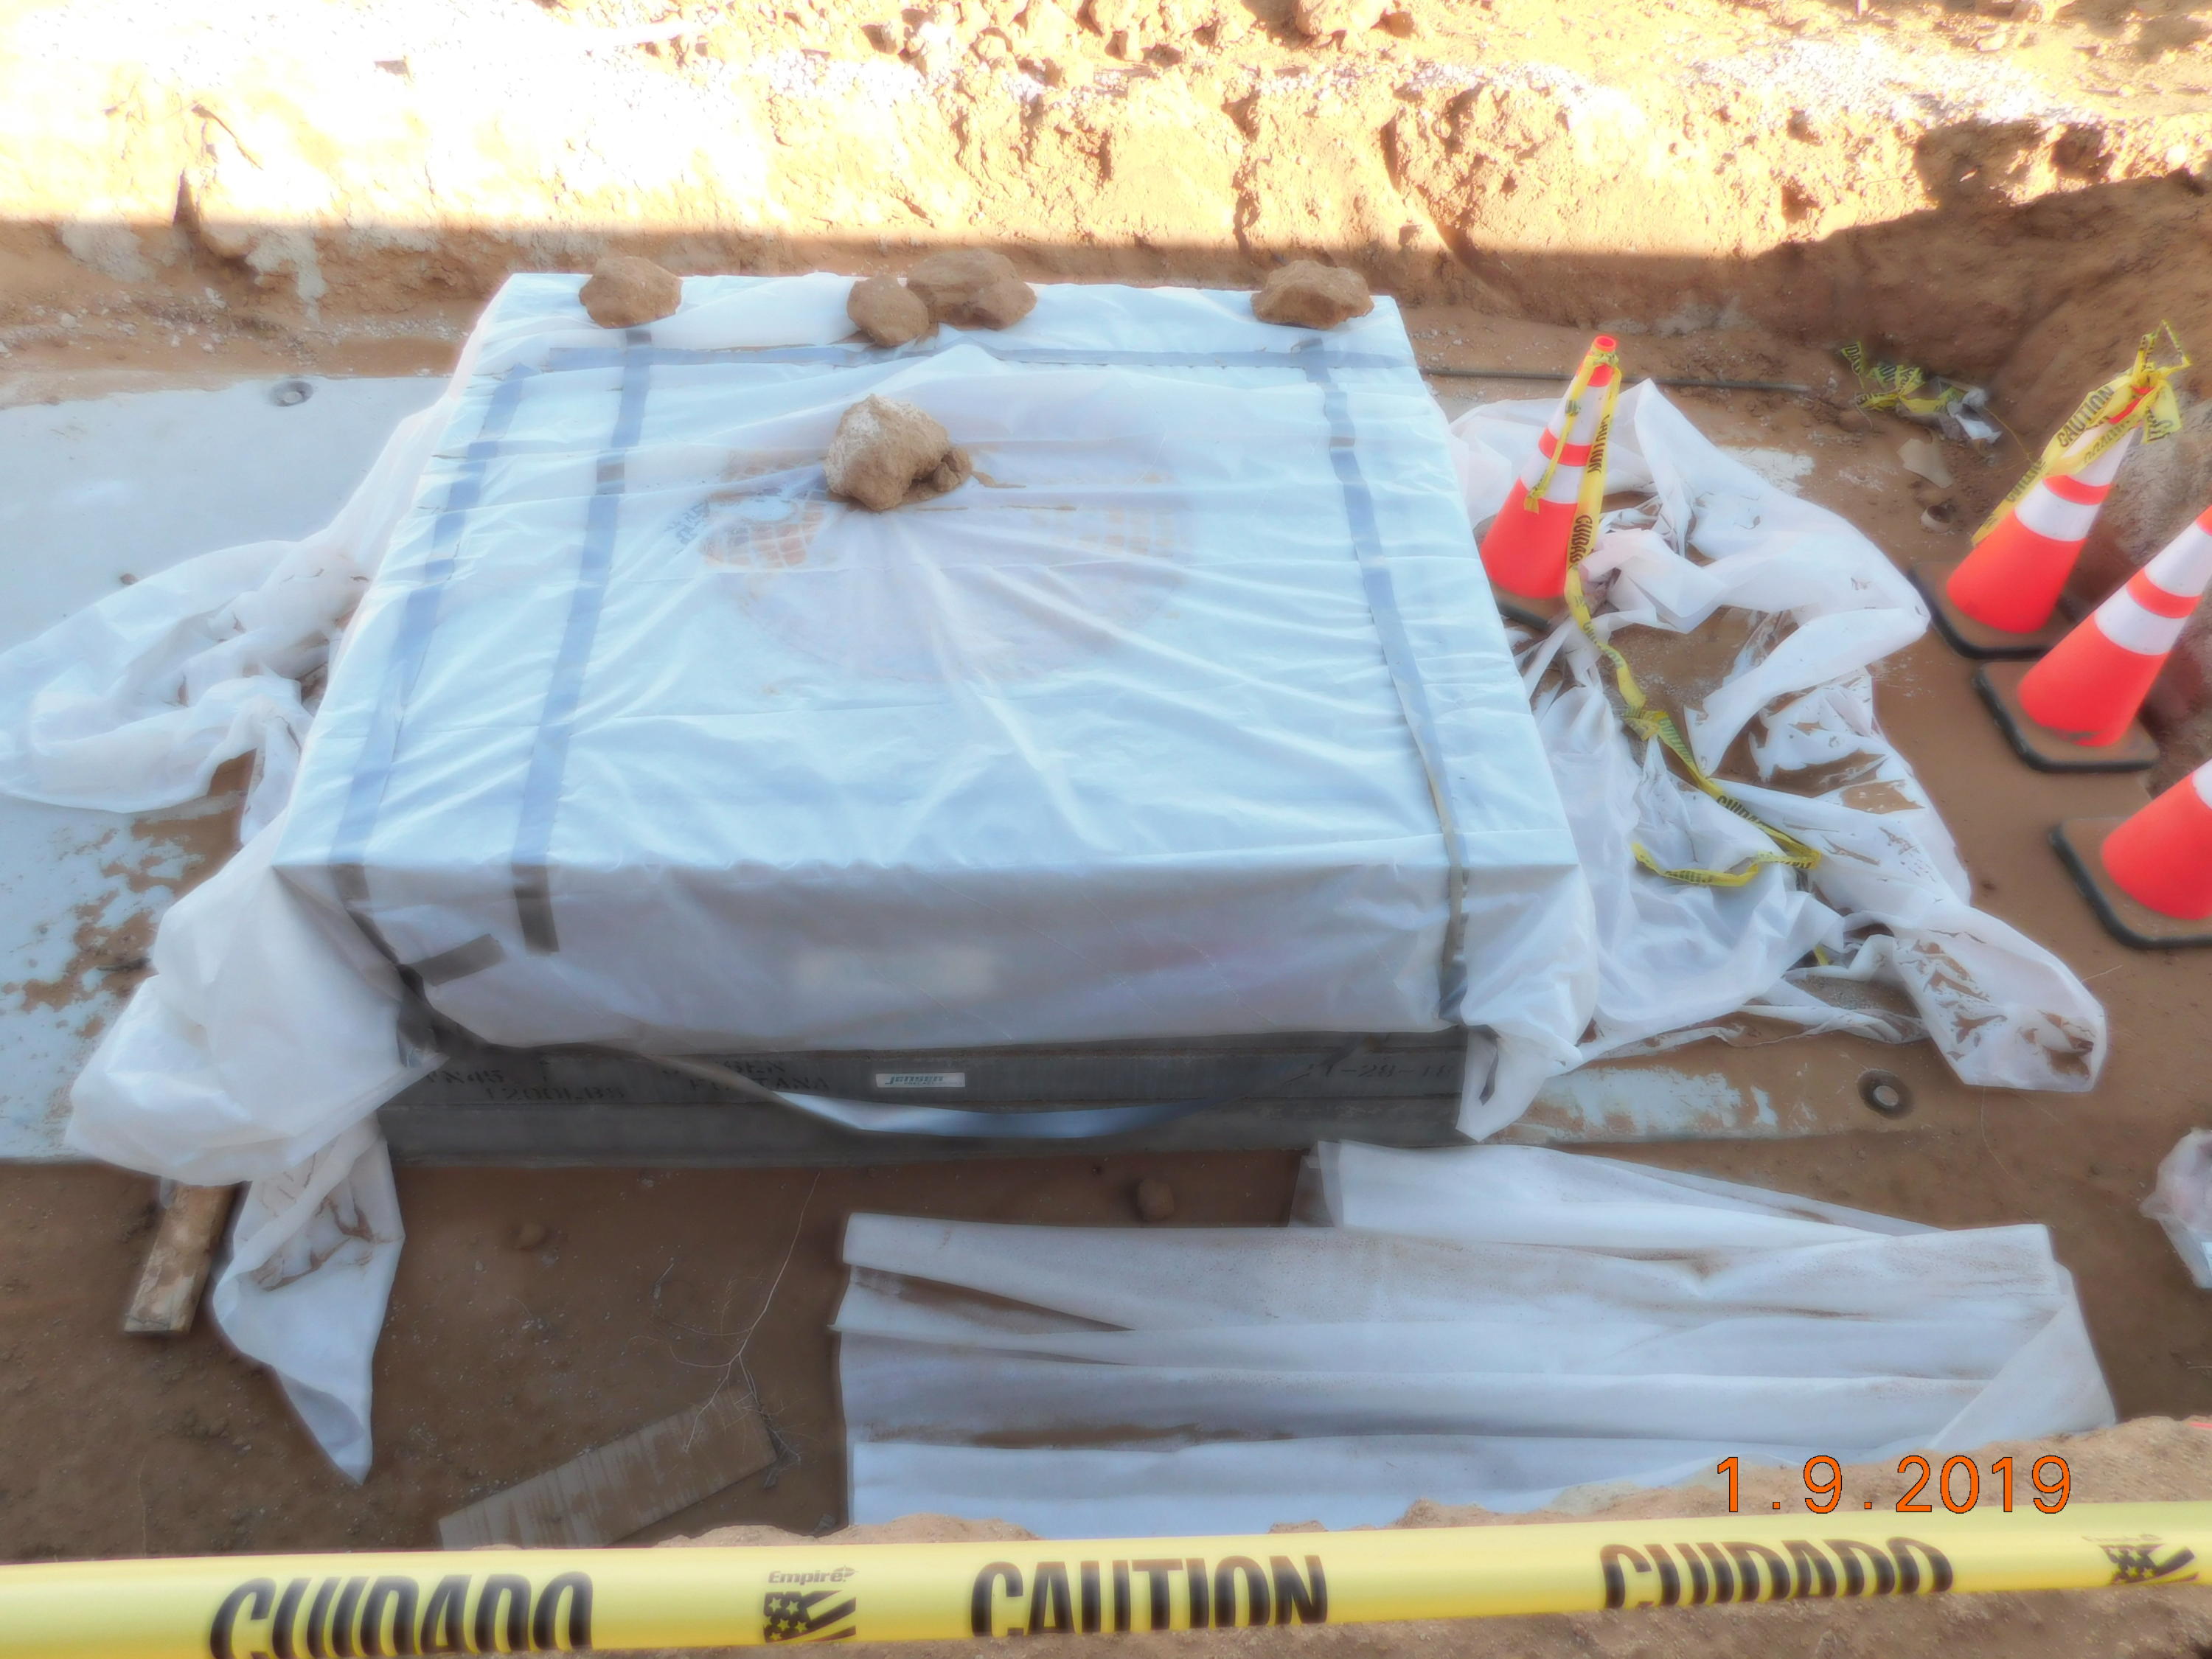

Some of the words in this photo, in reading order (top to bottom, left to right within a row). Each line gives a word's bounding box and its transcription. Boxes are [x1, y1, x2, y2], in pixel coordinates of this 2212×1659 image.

[2057, 384, 2115, 447] CAUTION
[1569, 514, 1594, 568] CUIDAD
[768, 1570, 844, 1586] Empire
[970, 1554, 1328, 1637] CAUTION
[1599, 1537, 1953, 1609] CUIDADO
[209, 1571, 594, 1659] CUIDADO
